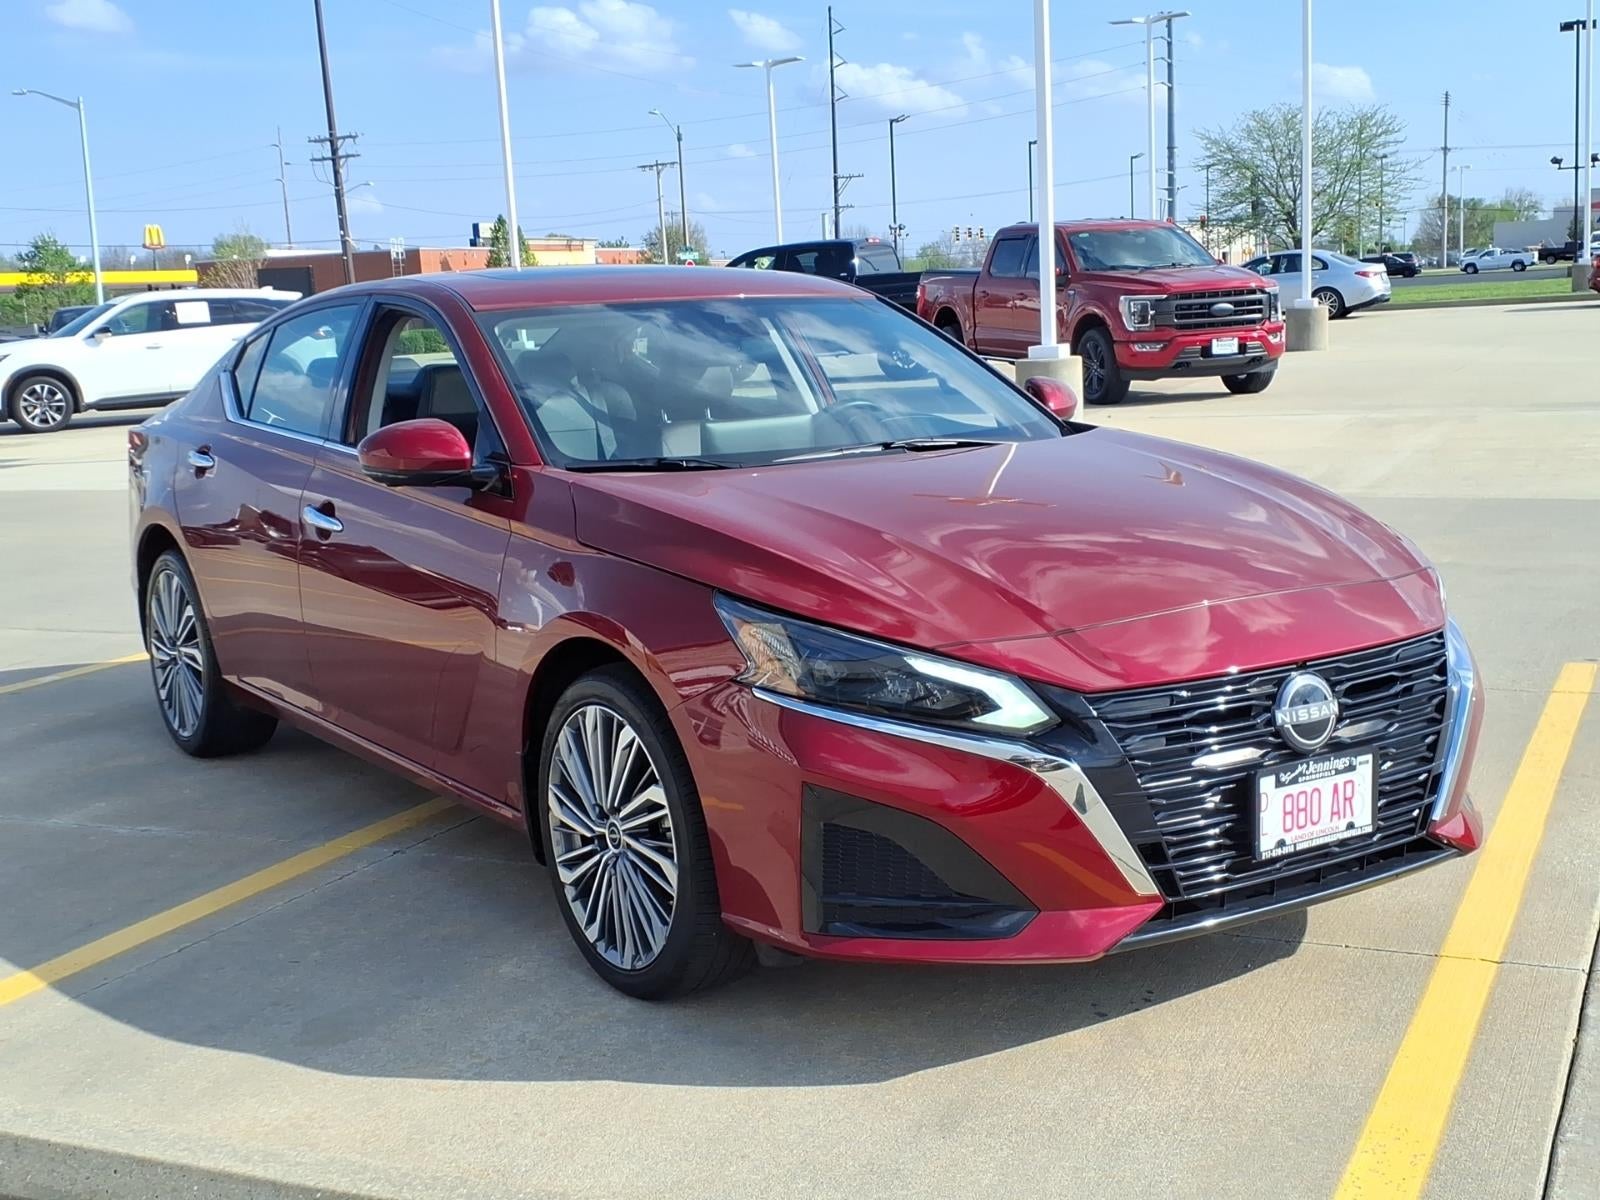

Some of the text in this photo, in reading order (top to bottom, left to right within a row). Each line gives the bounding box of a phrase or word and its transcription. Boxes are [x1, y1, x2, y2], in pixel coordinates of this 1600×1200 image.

[1276, 702, 1339, 724] NISSAN
[1306, 756, 1350, 775] Jennings
[1298, 770, 1336, 782] SPRINGFIELD
[1283, 779, 1355, 834] 880 AR
[1290, 831, 1307, 842] LAND
